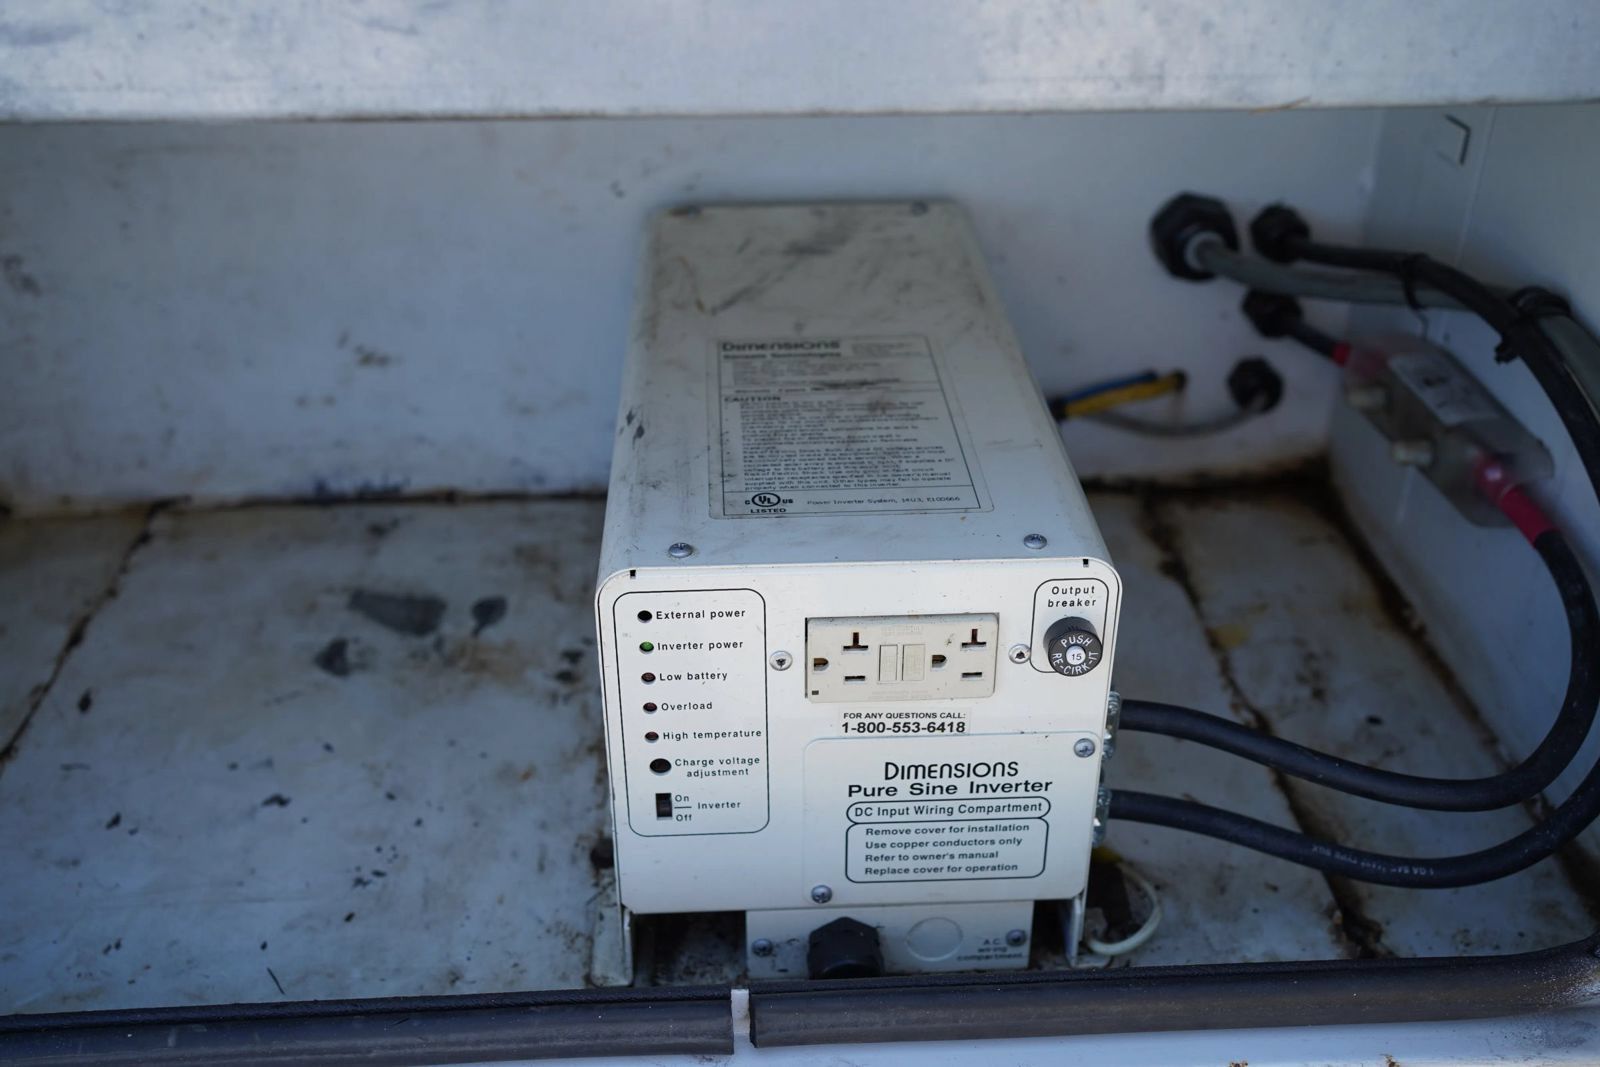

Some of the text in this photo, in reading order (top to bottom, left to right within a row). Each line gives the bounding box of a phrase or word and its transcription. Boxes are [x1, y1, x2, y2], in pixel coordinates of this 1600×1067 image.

[1052, 586, 1096, 596] Output
[1048, 598, 1096, 608] breaker
[656, 610, 746, 620] External power
[658, 641, 744, 651] Inverter power
[1060, 635, 1093, 648] PUSH
[1072, 653, 1082, 661] 15
[660, 672, 728, 681] Low battery
[661, 702, 713, 711] Overload
[842, 722, 966, 734] 1-800-553-6418
[663, 730, 762, 742] High temperature
[675, 757, 760, 768] Charge voltage
[687, 768, 749, 778] adjustment
[848, 780, 1053, 798] Pure Sine Inverter
[674, 794, 690, 802] On
[698, 802, 742, 810] Inverter
[855, 802, 1042, 818] DC Input Wiring Compartment
[676, 814, 692, 822] Off
[866, 828, 912, 836] Remove
[914, 826, 946, 834] cover
[968, 824, 1030, 833] installation
[890, 840, 929, 850] copper
[932, 838, 996, 848] conductors
[998, 837, 1022, 846] only
[865, 854, 896, 862] Refer
[912, 852, 955, 861] owner's
[958, 851, 999, 860] manual
[865, 864, 1018, 876] Replace cover for operation
